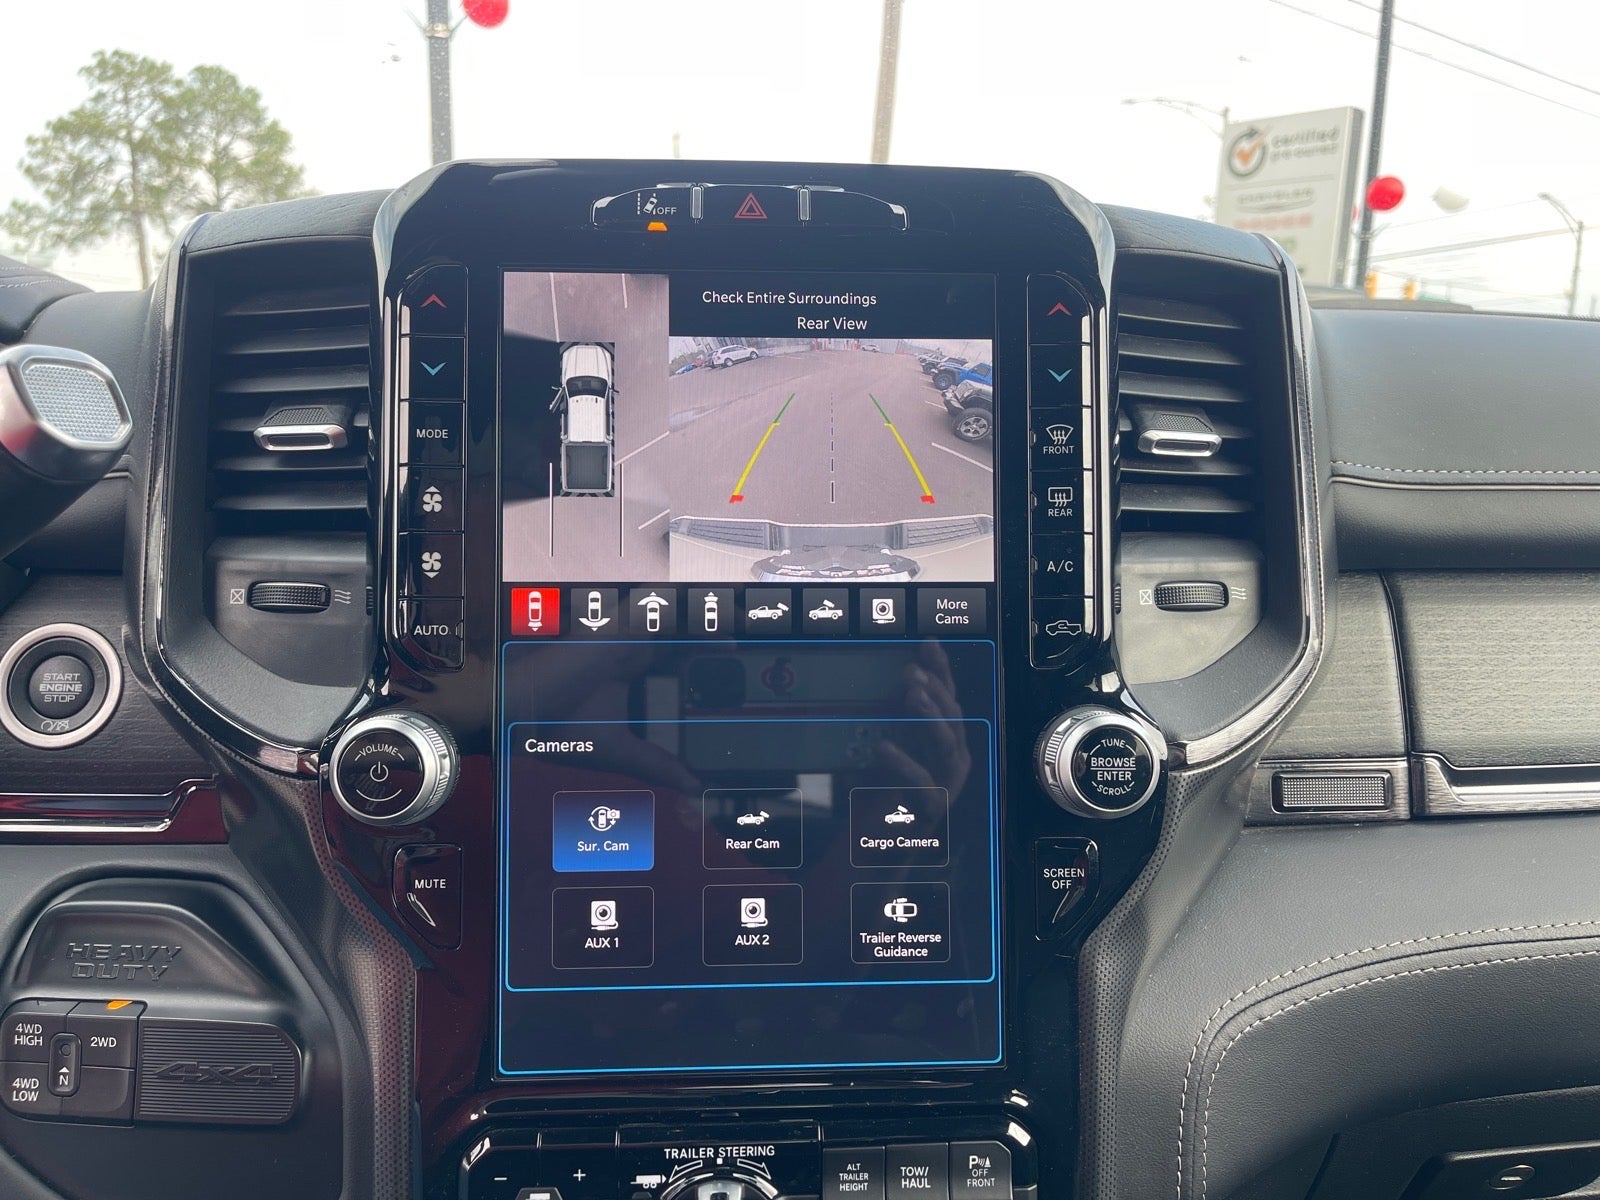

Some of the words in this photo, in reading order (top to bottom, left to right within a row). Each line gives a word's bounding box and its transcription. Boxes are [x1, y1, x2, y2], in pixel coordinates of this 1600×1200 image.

[656, 206, 677, 215] OFF
[702, 290, 744, 304] Check
[747, 291, 786, 304] Entire
[788, 291, 877, 308] Surroundings
[797, 316, 830, 330] Rear
[832, 316, 868, 330] View
[416, 428, 449, 439] MODE
[1043, 446, 1075, 455] FRONT
[1047, 508, 1073, 517] REAR
[1046, 560, 1074, 573] A/C
[936, 597, 968, 611] More
[935, 612, 969, 626] Cams
[413, 624, 449, 636] AUTO
[43, 672, 81, 681] START
[39, 683, 83, 692] ENGINE
[43, 694, 76, 703] STOP
[525, 738, 594, 753] Cameras
[1101, 738, 1126, 749] TUNE
[359, 743, 399, 757] VOLUME
[1091, 757, 1136, 768] BROWSE
[1097, 771, 1133, 782] ENTER
[1096, 784, 1131, 796] SCROLL
[577, 840, 601, 852] Sur.
[603, 840, 630, 852] Cam
[725, 838, 753, 850] Rear
[754, 837, 781, 850] Cam
[859, 836, 895, 850] Cargo
[896, 836, 940, 849] Camera
[1043, 868, 1085, 878] SCREEN
[414, 878, 447, 890] MUTE
[1051, 879, 1072, 890] OFF
[584, 937, 611, 949] AUX
[613, 937, 620, 949] 1
[734, 934, 760, 946] AUX
[761, 934, 770, 946] 2
[859, 931, 897, 944] Trailer
[898, 931, 942, 944] Reverse
[66, 942, 182, 962] HEAVY
[873, 945, 929, 958] Guidance
[71, 962, 170, 981] DUTY
[15, 1023, 43, 1035] 4WD
[14, 1034, 43, 1047] HIGH
[90, 1036, 117, 1048] 2WD
[12, 1077, 40, 1089] 4WD
[58, 1074, 69, 1086] N
[12, 1090, 39, 1102] LOW
[663, 1148, 715, 1160] TRAILER
[718, 1145, 775, 1158] STEERING
[846, 1163, 861, 1171] ALT
[900, 1166, 929, 1177] TOW/
[971, 1168, 989, 1177] OFF
[839, 1172, 869, 1181] TRAILER
[966, 1177, 996, 1188] FRONT
[839, 1182, 869, 1192] HEIGHT
[901, 1178, 931, 1189] HAUL
